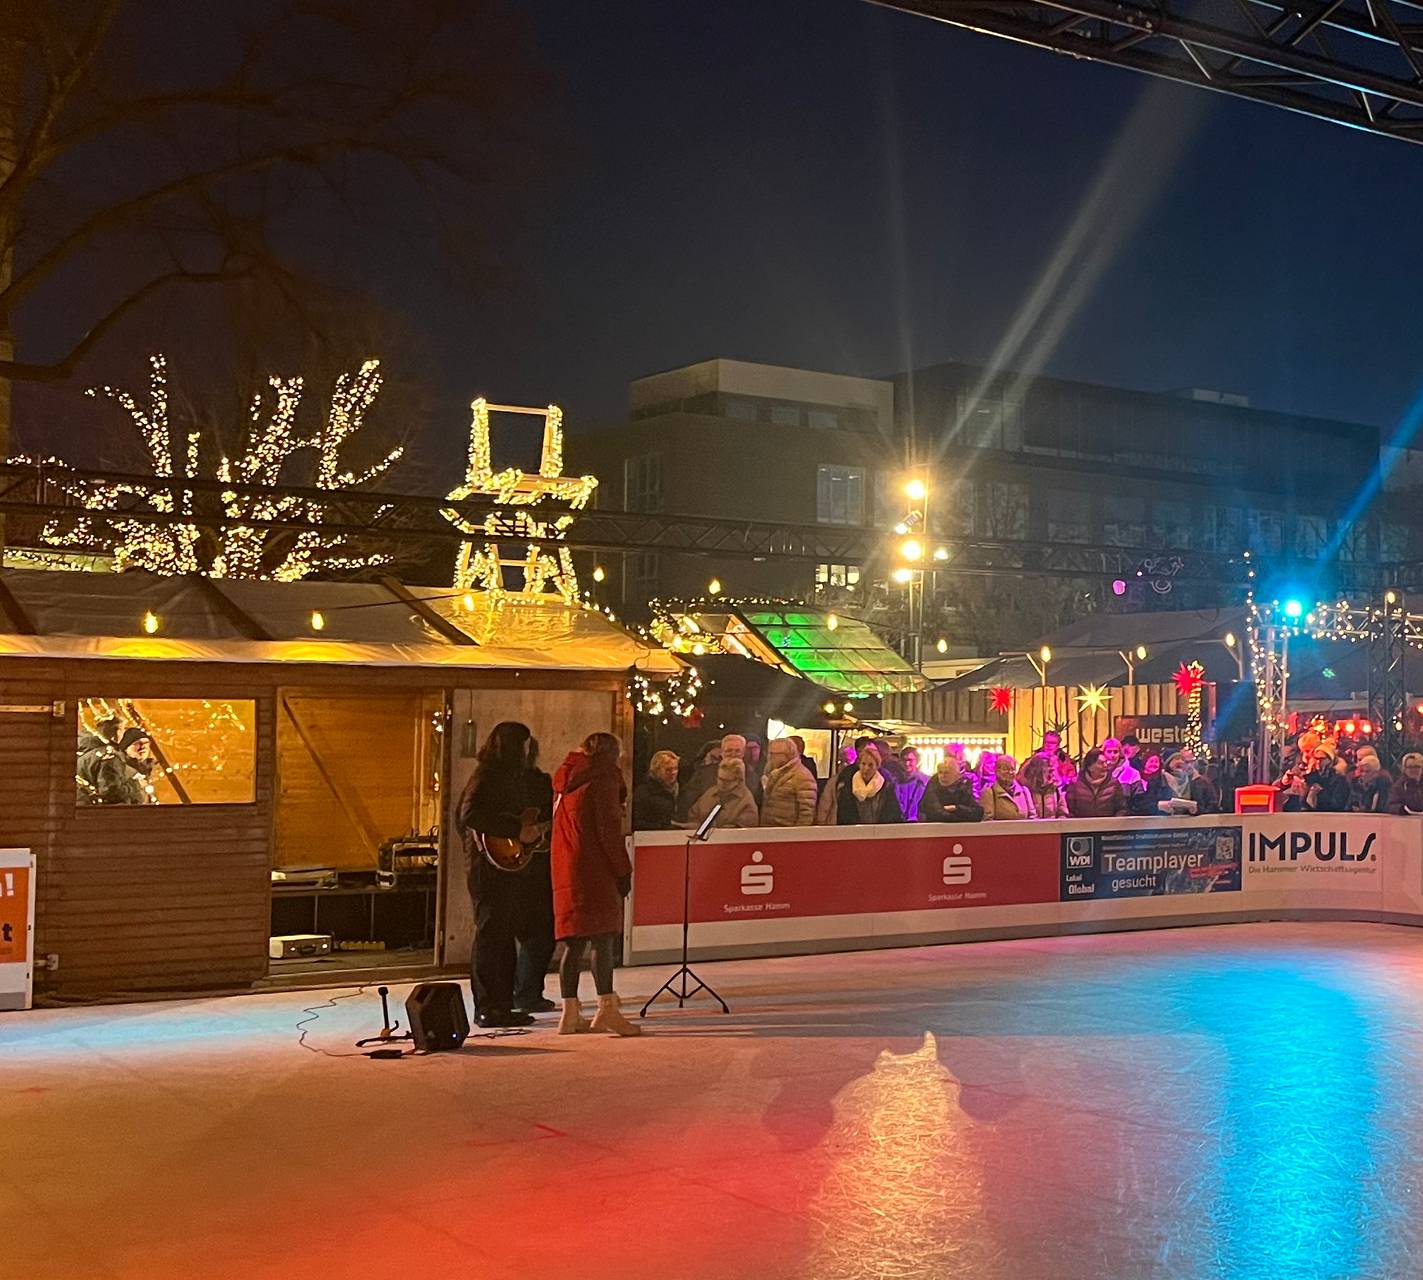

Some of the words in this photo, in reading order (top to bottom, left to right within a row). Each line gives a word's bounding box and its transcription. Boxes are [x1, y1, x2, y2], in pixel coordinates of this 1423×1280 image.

[1069, 855, 1090, 866] WDI
[1104, 851, 1203, 874] Teamplayer
[1068, 883, 1094, 894] Global
[1111, 876, 1156, 892] gesucht
